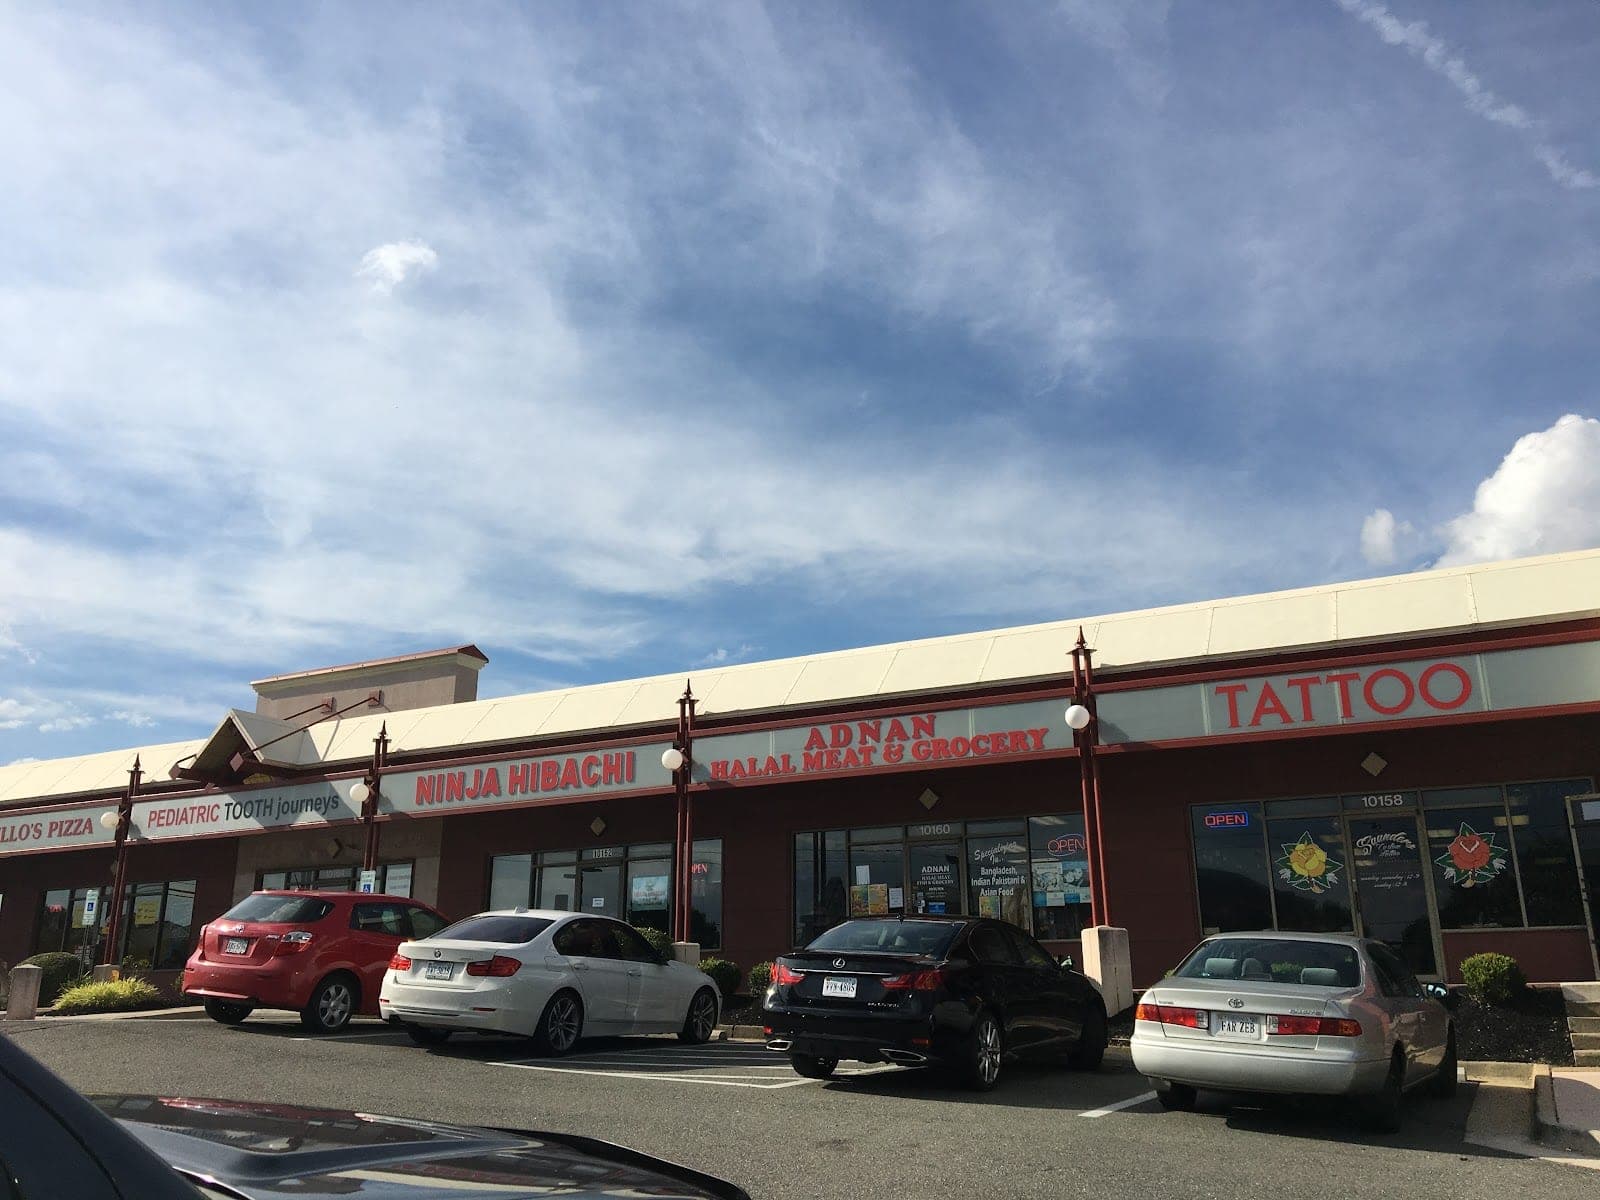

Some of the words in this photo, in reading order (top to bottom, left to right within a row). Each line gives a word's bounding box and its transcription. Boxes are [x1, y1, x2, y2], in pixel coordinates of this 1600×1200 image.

[1215, 663, 1472, 728] TATTOO
[804, 713, 937, 751] ADNAN
[710, 754, 796, 780] HALAL
[802, 745, 877, 772] MEAT
[883, 744, 904, 764] &
[911, 728, 1049, 762] GROCERY
[415, 767, 501, 806] NINJA
[508, 751, 636, 795] HIBACHI
[1361, 794, 1403, 807] 10158
[147, 803, 220, 829] PEDIATRIC
[224, 798, 274, 819] TOOTH
[275, 793, 340, 818] journeys
[1205, 813, 1245, 827] OPEN
[0, 822, 43, 843] LLO'S
[47, 817, 94, 838] PIZZA
[920, 824, 950, 836] 10160
[1048, 838, 1086, 853] OPEN
[691, 863, 708, 874] PEN
[921, 865, 950, 873] ADNAN
[981, 866, 1018, 877] Bangladesh,
[971, 877, 991, 886] Indian
[992, 876, 1019, 885] Pakistani
[980, 888, 997, 896] Asian
[998, 887, 1014, 896] Food
[1221, 1020, 1236, 1032] FAR
[1240, 1021, 1255, 1034] ZEB
